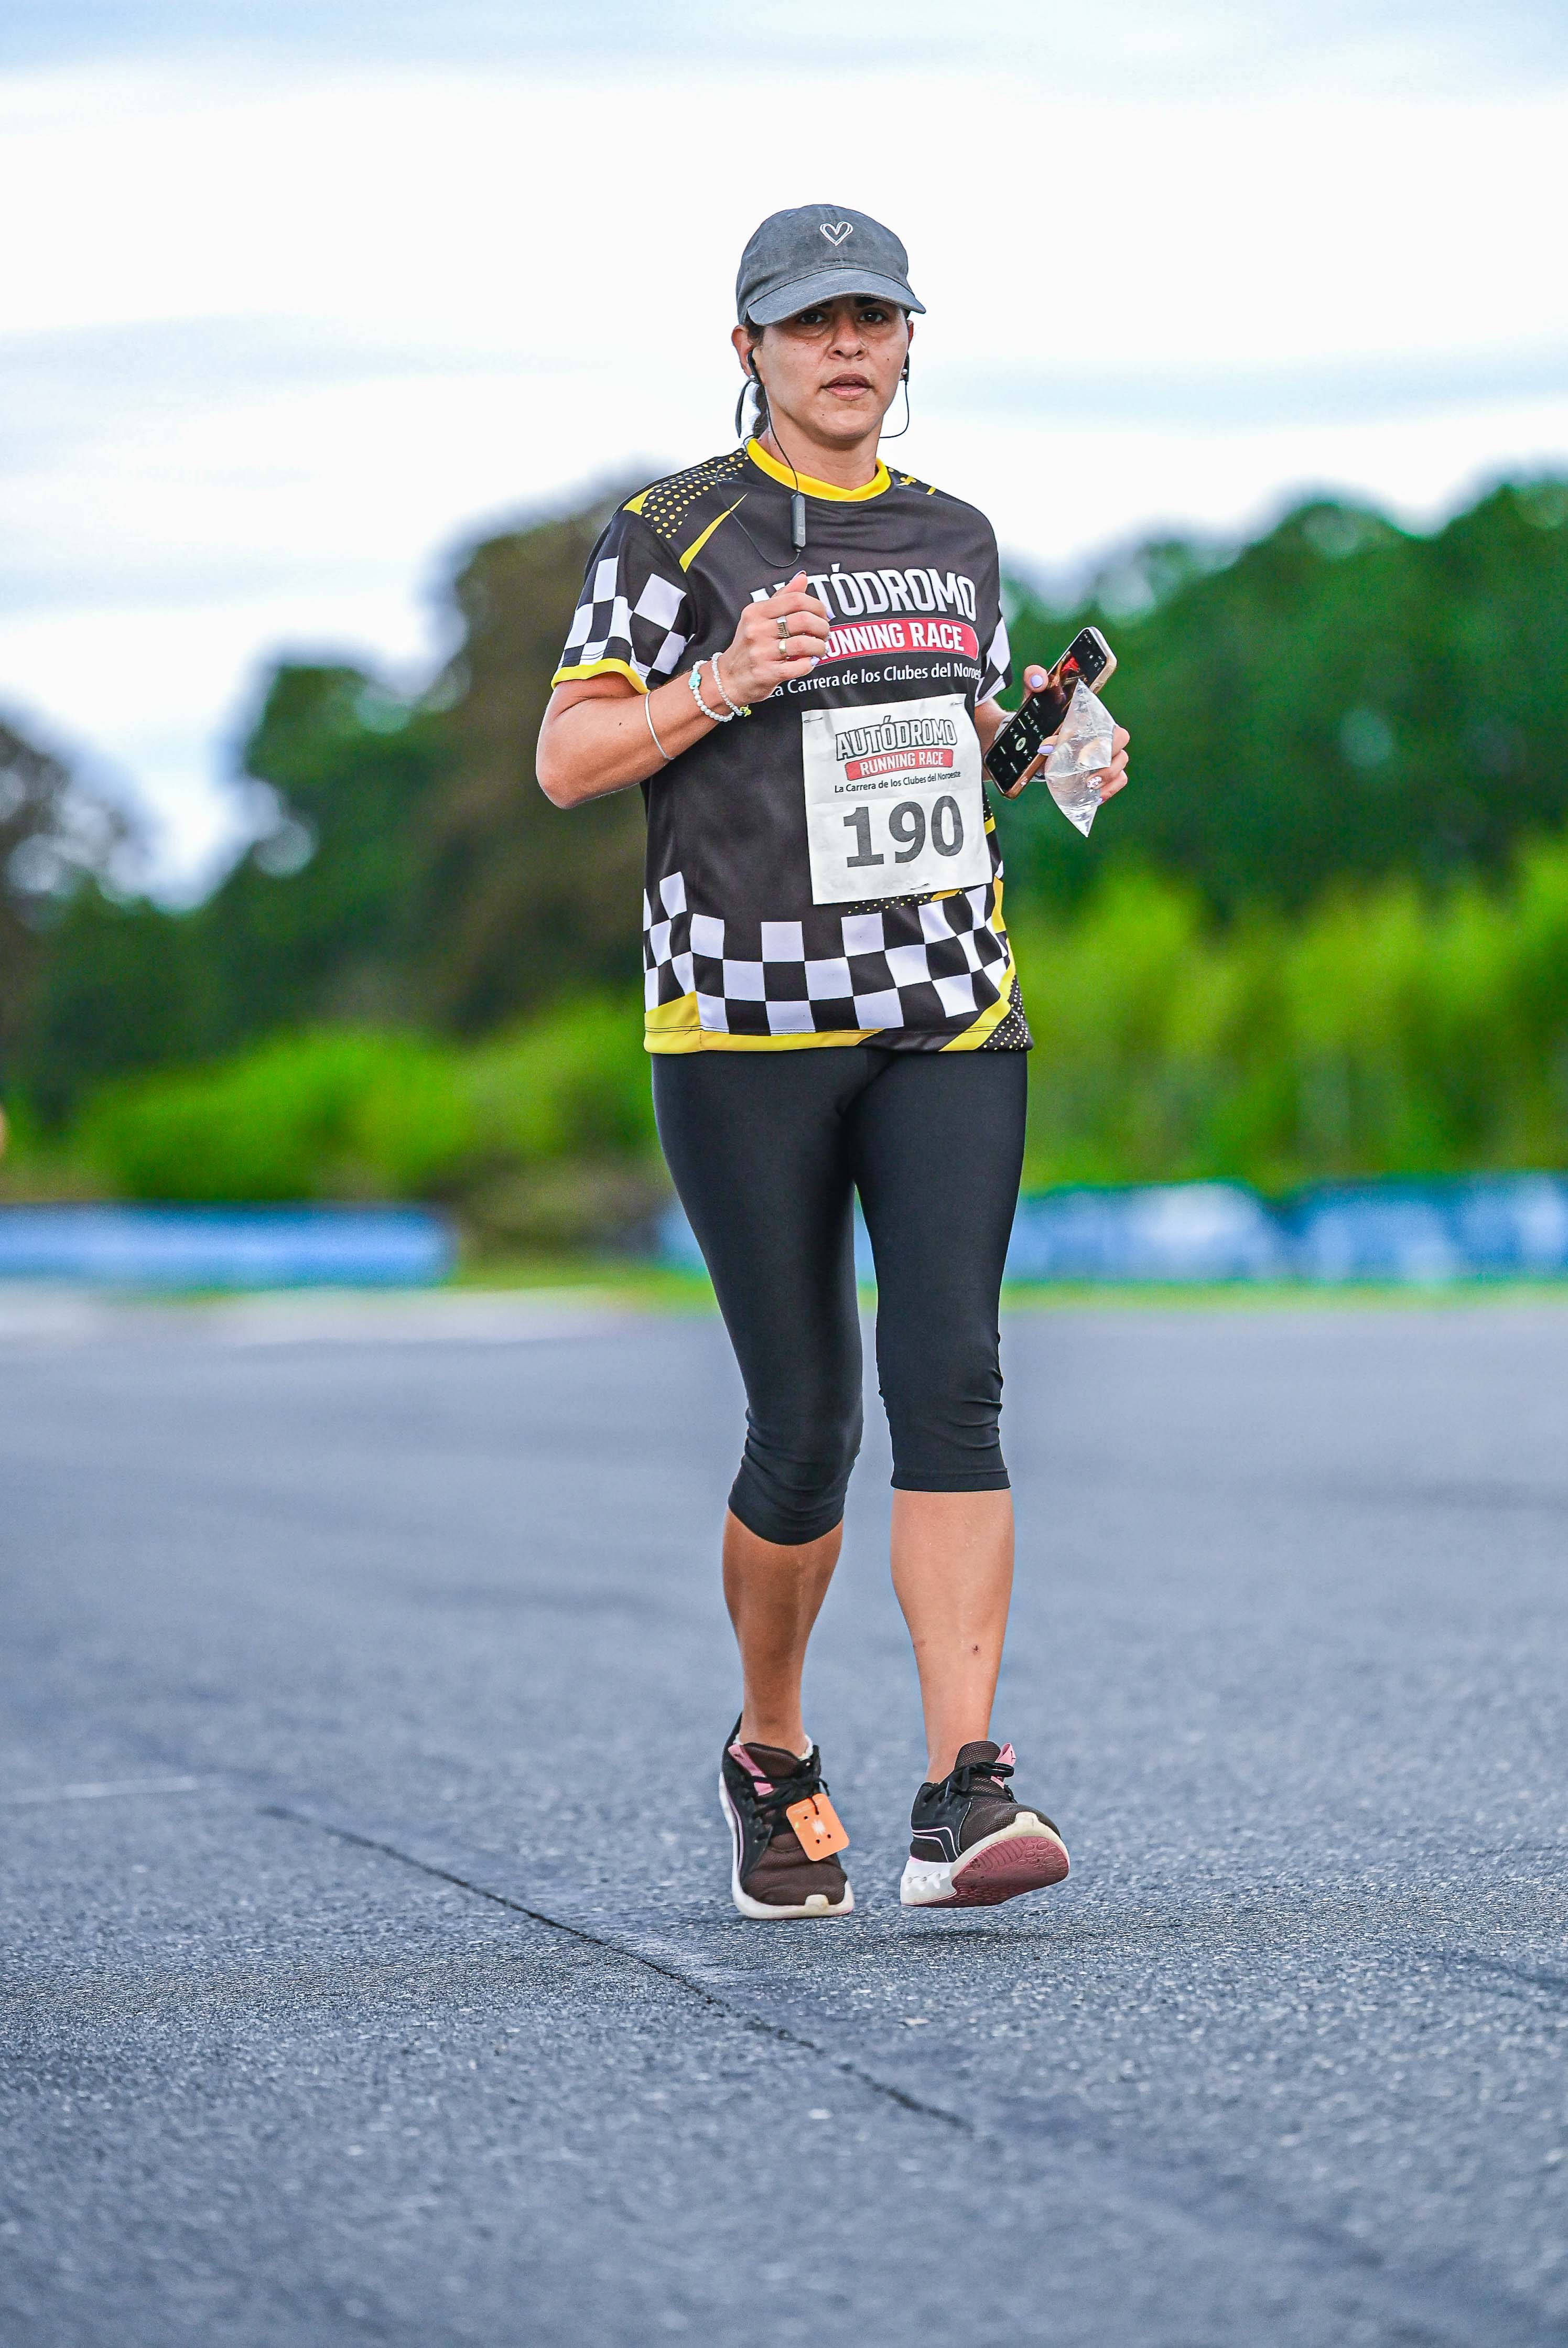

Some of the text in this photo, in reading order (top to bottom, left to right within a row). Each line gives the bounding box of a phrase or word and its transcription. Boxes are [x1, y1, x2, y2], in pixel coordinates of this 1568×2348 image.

[750, 563, 977, 622] TÓDROMO
[821, 622, 905, 660] UNNING
[909, 622, 965, 652] RACE
[787, 675, 840, 693] Carrera
[842, 670, 858, 685] de
[861, 669, 881, 683] los
[883, 664, 928, 681] Clubes
[931, 662, 951, 678] del
[836, 715, 958, 761] AUTÓDROMO
[835, 770, 961, 793] La Carrera de los Clubes del Noroeste
[859, 751, 944, 776] RUNNING RACE
[843, 795, 964, 868] 190
